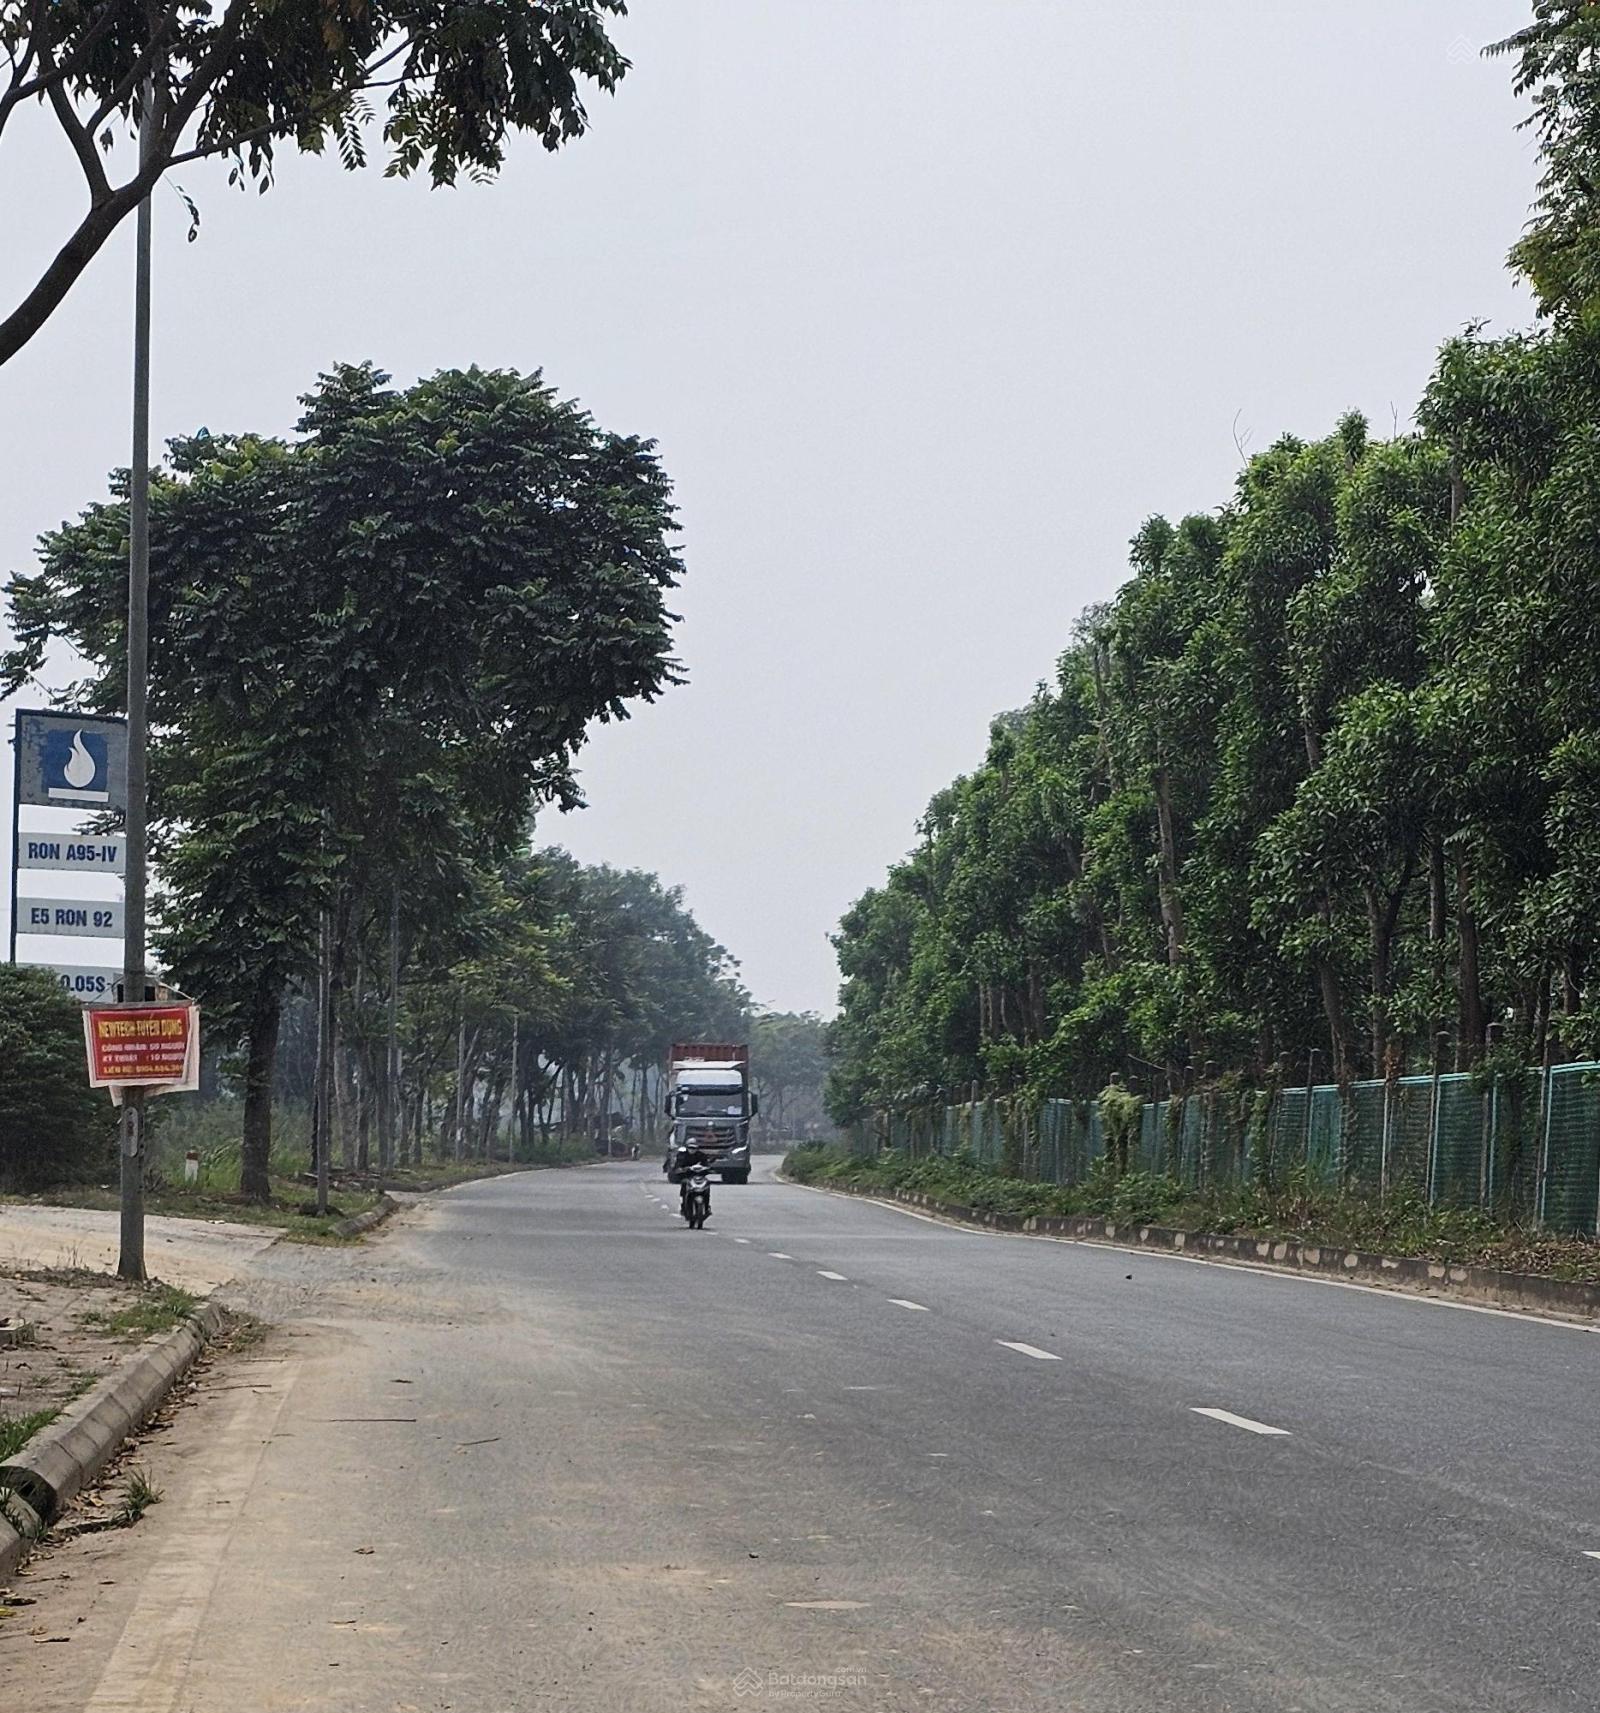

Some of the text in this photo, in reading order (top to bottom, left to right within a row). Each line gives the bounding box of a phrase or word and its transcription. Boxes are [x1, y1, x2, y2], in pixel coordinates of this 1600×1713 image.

[28, 842, 117, 862] RON A95-IV
[31, 907, 113, 928] E5 RON 92
